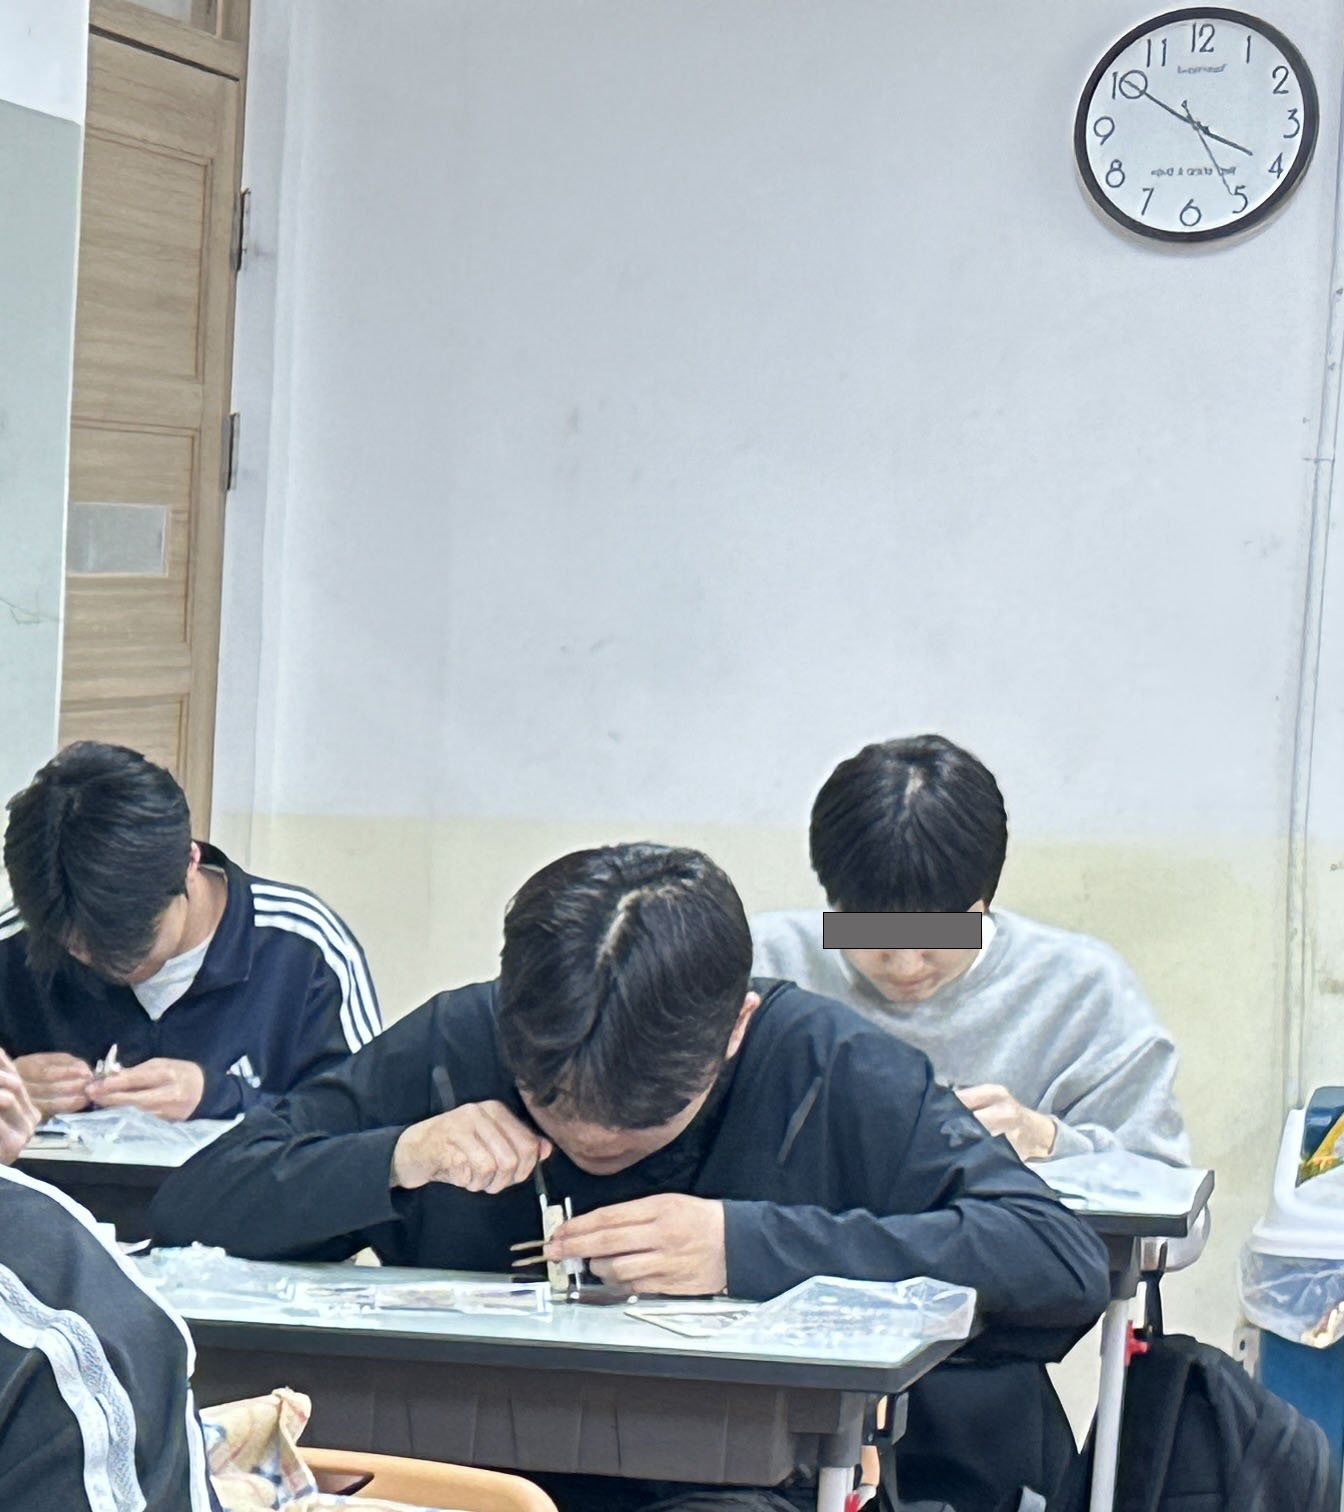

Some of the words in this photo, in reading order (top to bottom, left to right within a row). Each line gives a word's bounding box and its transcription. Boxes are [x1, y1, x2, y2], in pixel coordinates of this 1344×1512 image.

[1190, 22, 1216, 53] 12
[1245, 34, 1253, 64] 1
[1146, 38, 1168, 68] 11
[1111, 70, 1148, 100] 10
[1271, 65, 1290, 95] 2
[1093, 116, 1115, 146] 9
[1283, 108, 1300, 138] 3
[1105, 159, 1126, 188] 8
[1268, 152, 1284, 180] 4
[1140, 187, 1154, 215] 7
[1180, 198, 1201, 226] 6
[1232, 185, 1249, 214] 5
